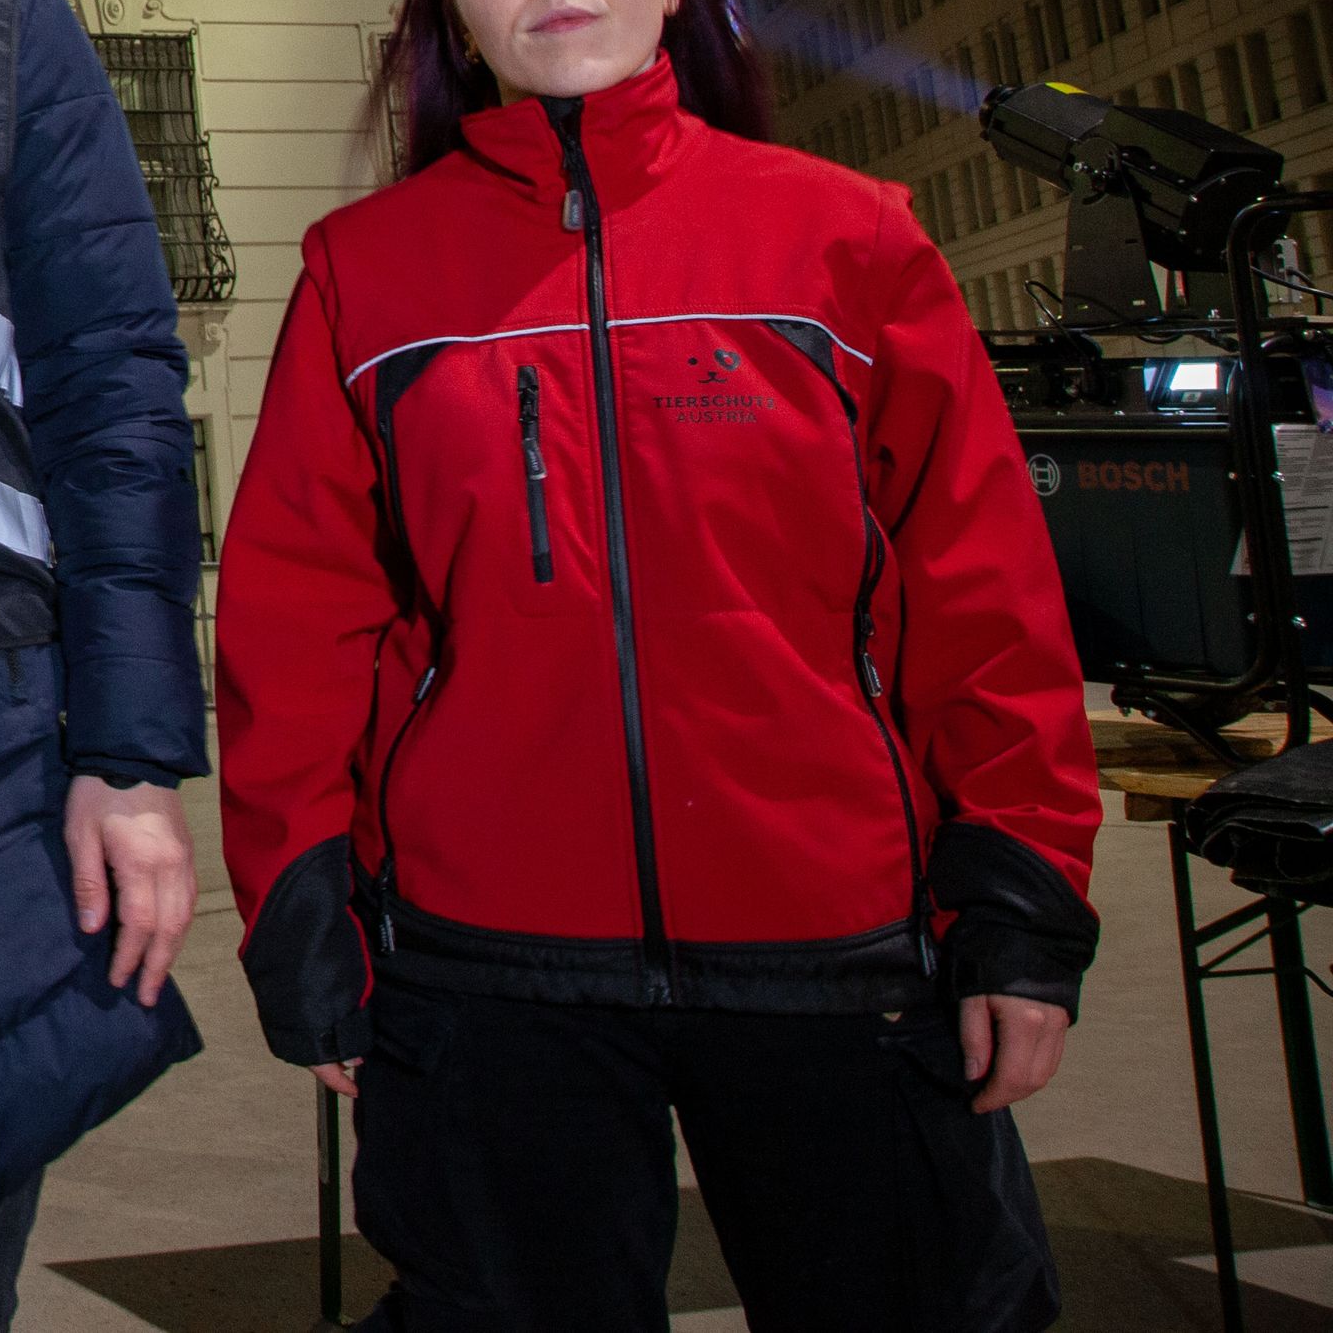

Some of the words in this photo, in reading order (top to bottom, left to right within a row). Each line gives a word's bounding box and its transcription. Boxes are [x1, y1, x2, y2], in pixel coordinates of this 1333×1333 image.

[652, 394, 775, 409] TIERSCHUTZ
[677, 411, 758, 425] AUSTRIA
[1077, 460, 1190, 493] BOSCH
